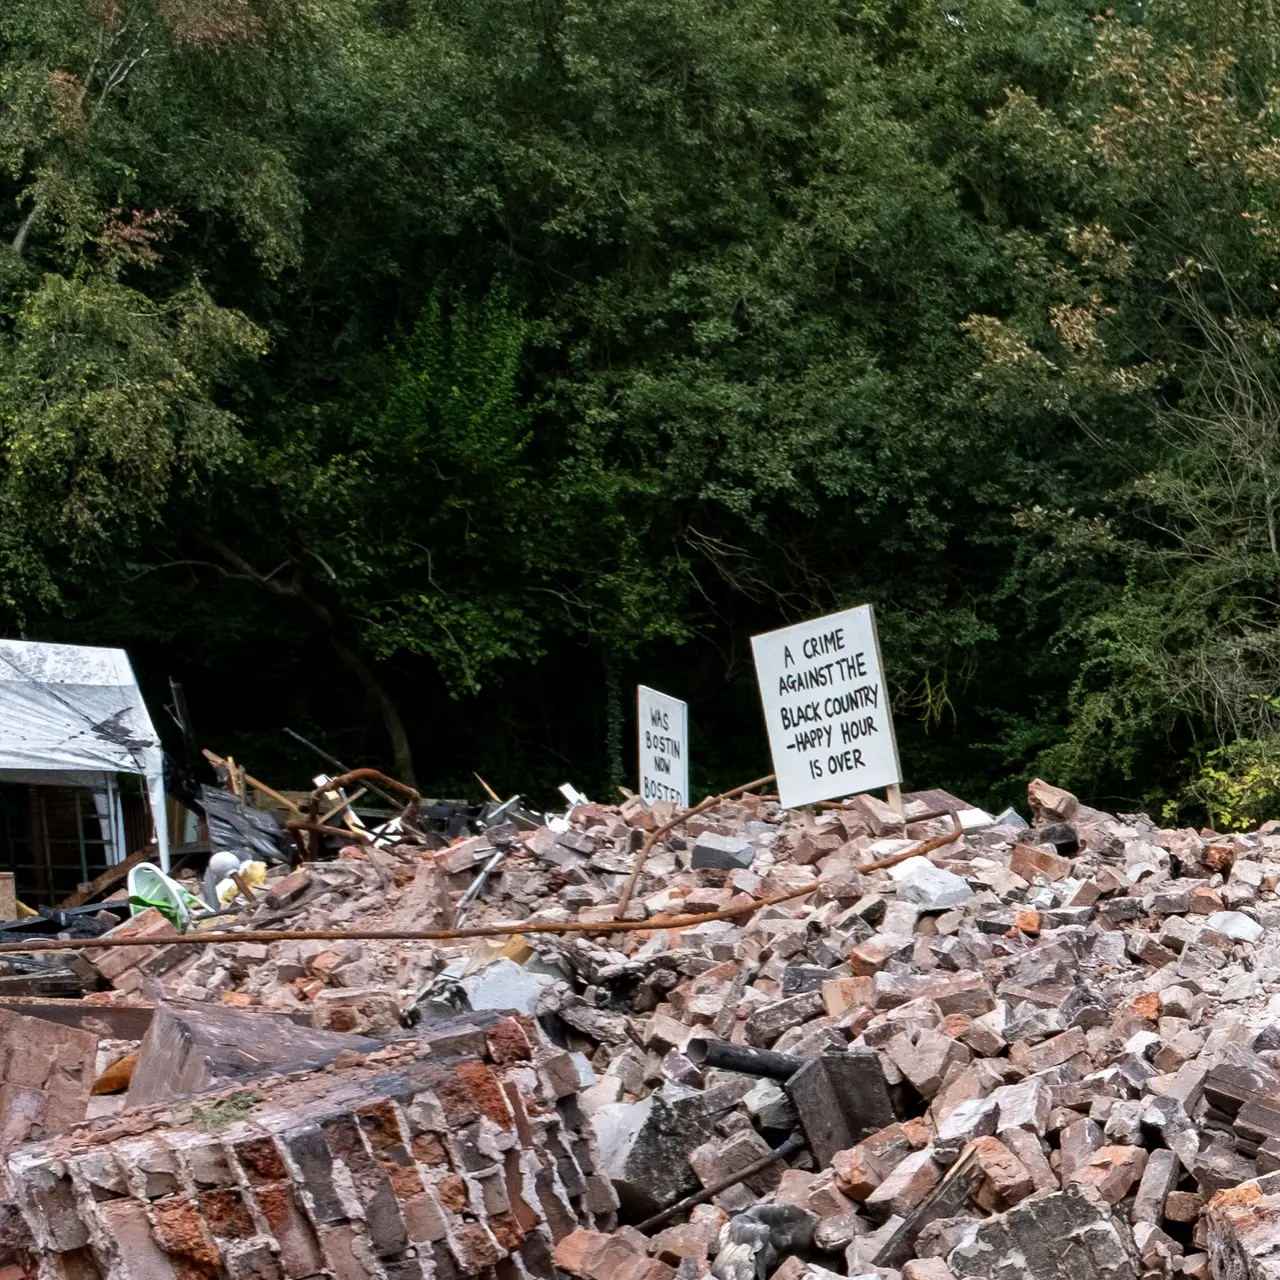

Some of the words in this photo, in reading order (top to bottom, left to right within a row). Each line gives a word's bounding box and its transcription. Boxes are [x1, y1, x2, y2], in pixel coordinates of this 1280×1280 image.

[784, 645, 795, 668] A
[803, 628, 845, 659] CRIME
[779, 663, 834, 696] AGAINST
[835, 652, 867, 681] THE
[650, 706, 669, 732] WAS
[781, 701, 822, 730] BLACK
[824, 683, 878, 719] COUNTRY
[840, 715, 878, 744] HOUR
[645, 730, 680, 759] BOSTIN
[654, 755, 671, 775] NOW
[809, 759, 823, 779] IS
[828, 749, 866, 775] OVER
